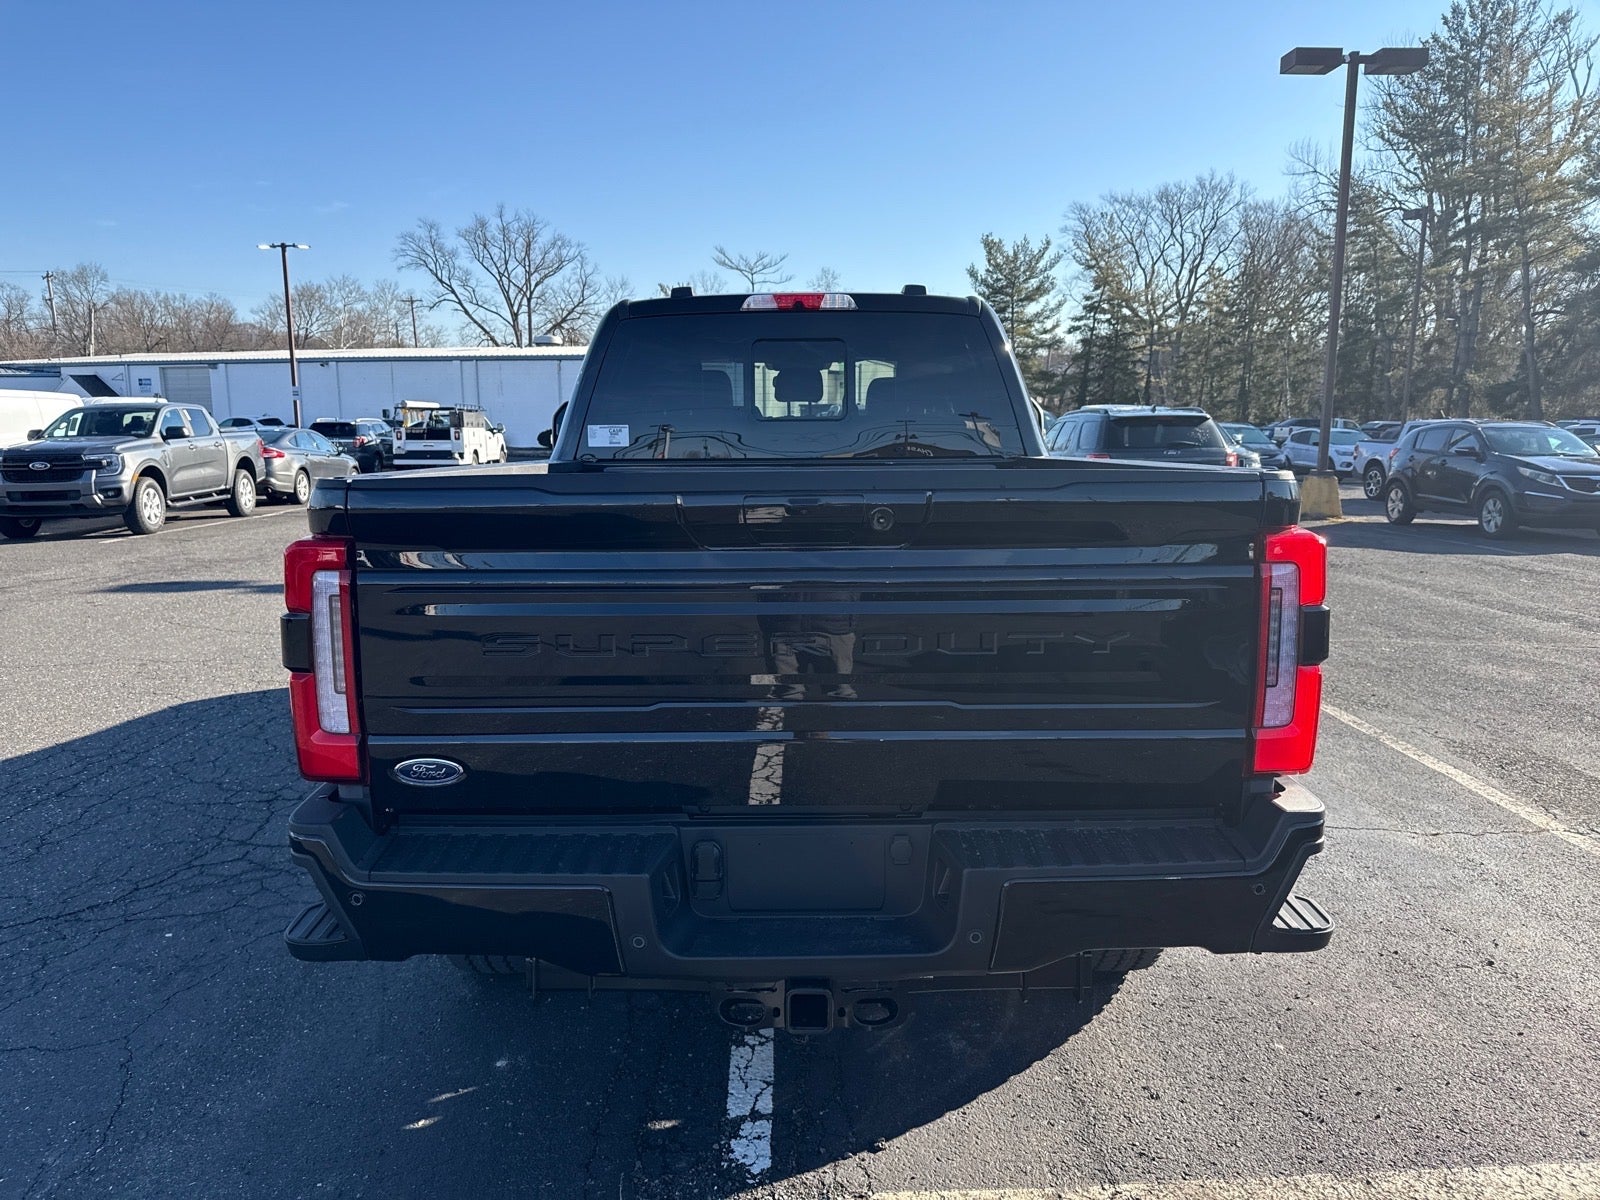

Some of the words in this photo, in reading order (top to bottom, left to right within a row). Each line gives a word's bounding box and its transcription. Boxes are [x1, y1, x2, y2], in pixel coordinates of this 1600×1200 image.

[481, 631, 834, 658] SUPER
[860, 630, 1131, 657] DUTY
[410, 764, 446, 778] Ford
